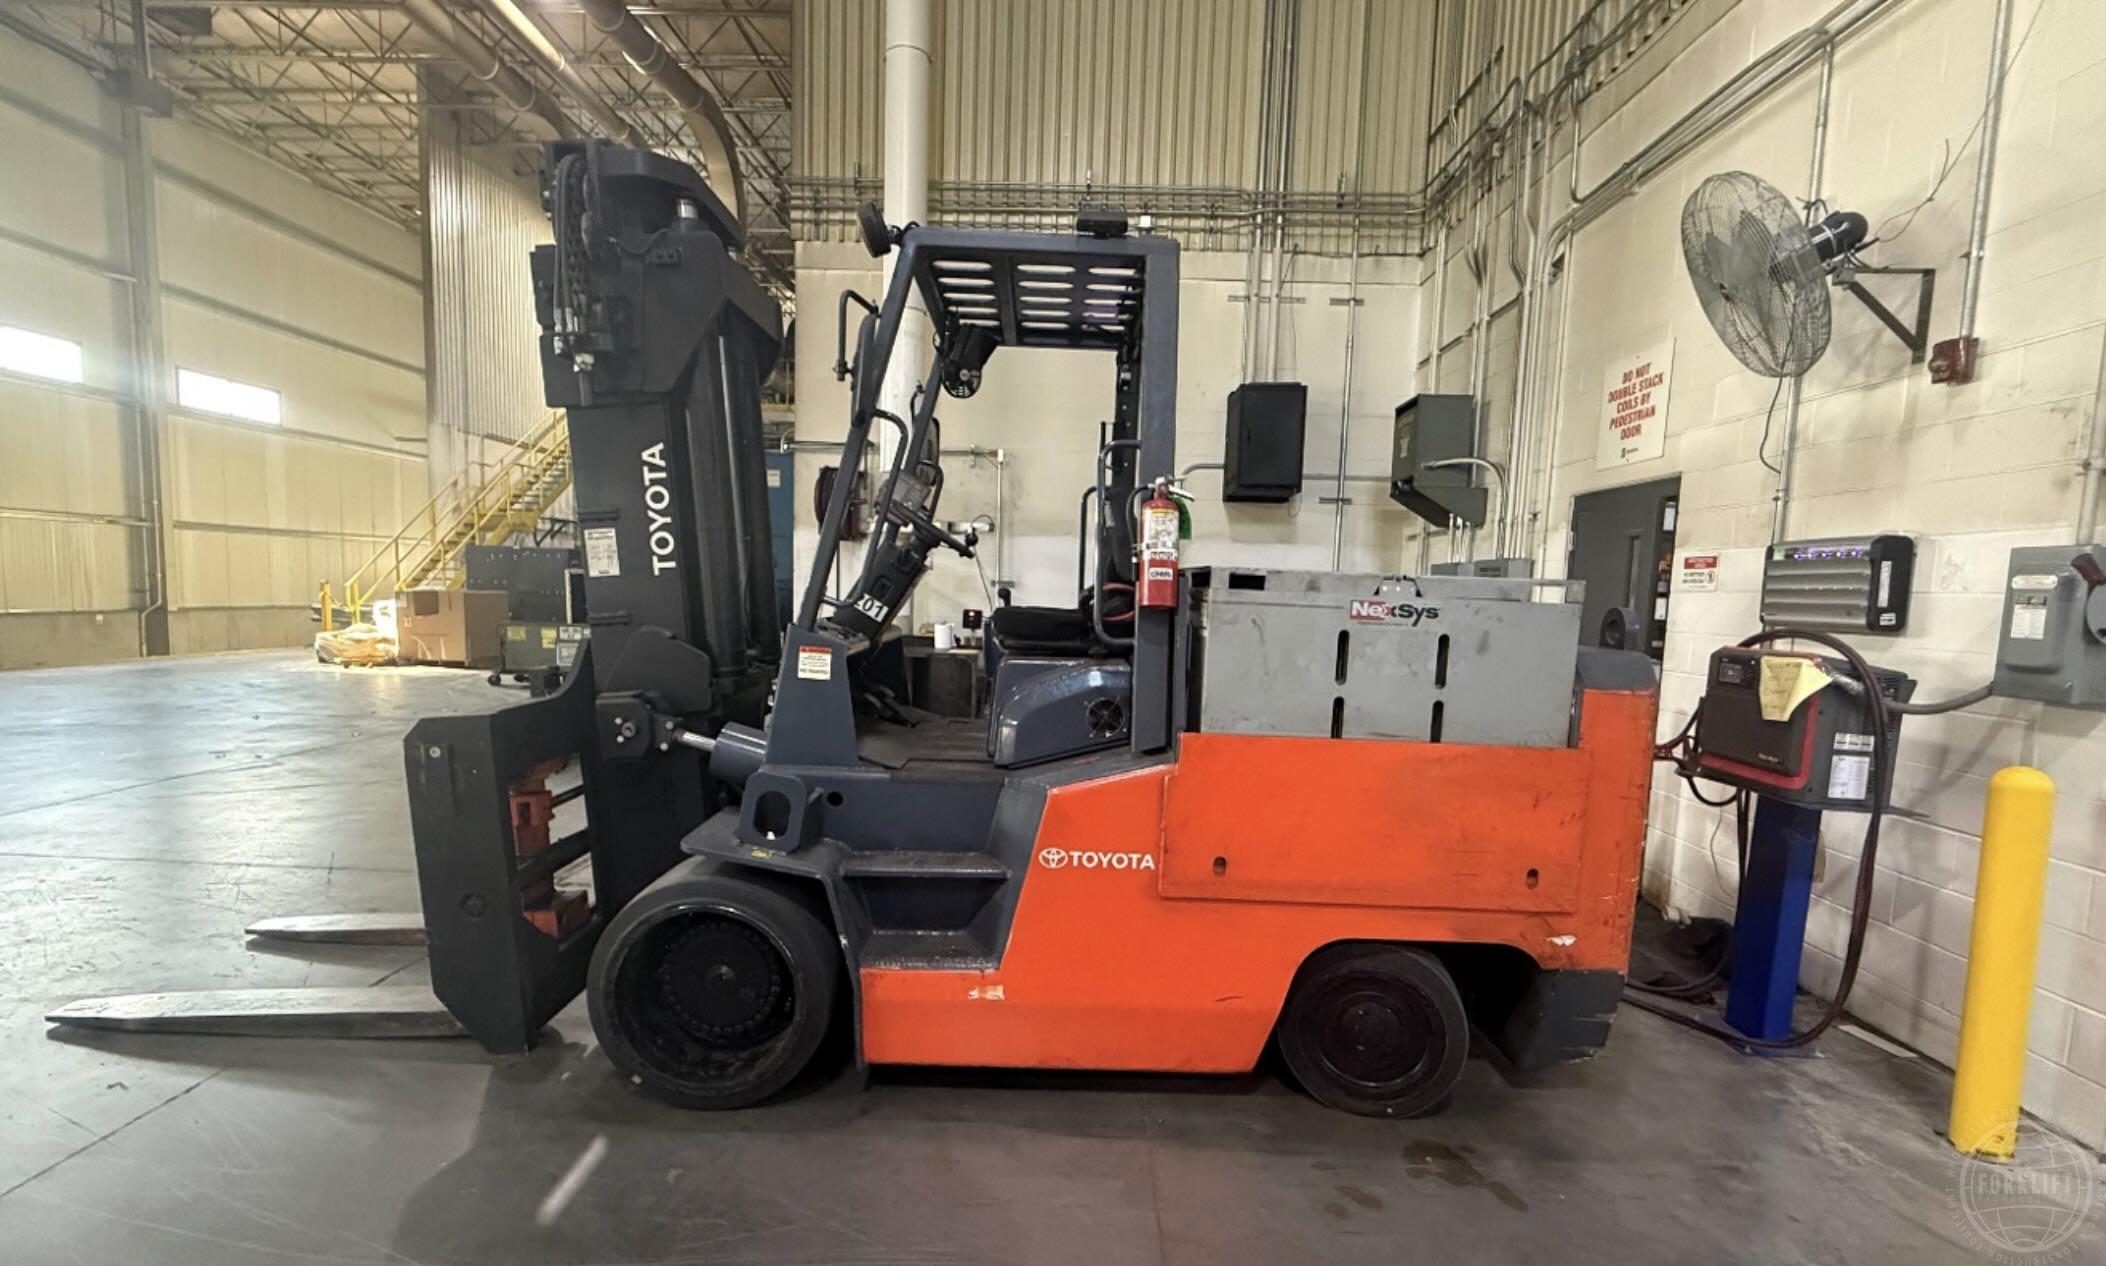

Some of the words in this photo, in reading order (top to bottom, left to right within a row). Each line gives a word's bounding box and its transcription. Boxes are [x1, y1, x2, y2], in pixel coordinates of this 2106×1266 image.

[1622, 370, 1634, 385] DO
[1636, 362, 1652, 379] NOT
[1608, 383, 1637, 403] DOUBLE
[1639, 372, 1664, 392] STACK
[1616, 396, 1639, 414] COILS
[1640, 391, 1651, 406] BY
[1608, 405, 1656, 431] PEDESTRIAN
[1620, 423, 1642, 440] DOOR
[641, 441, 677, 577] TOYOTA
[1351, 600, 1440, 627] NexSys
[1068, 851, 1156, 870] TOYOTA
